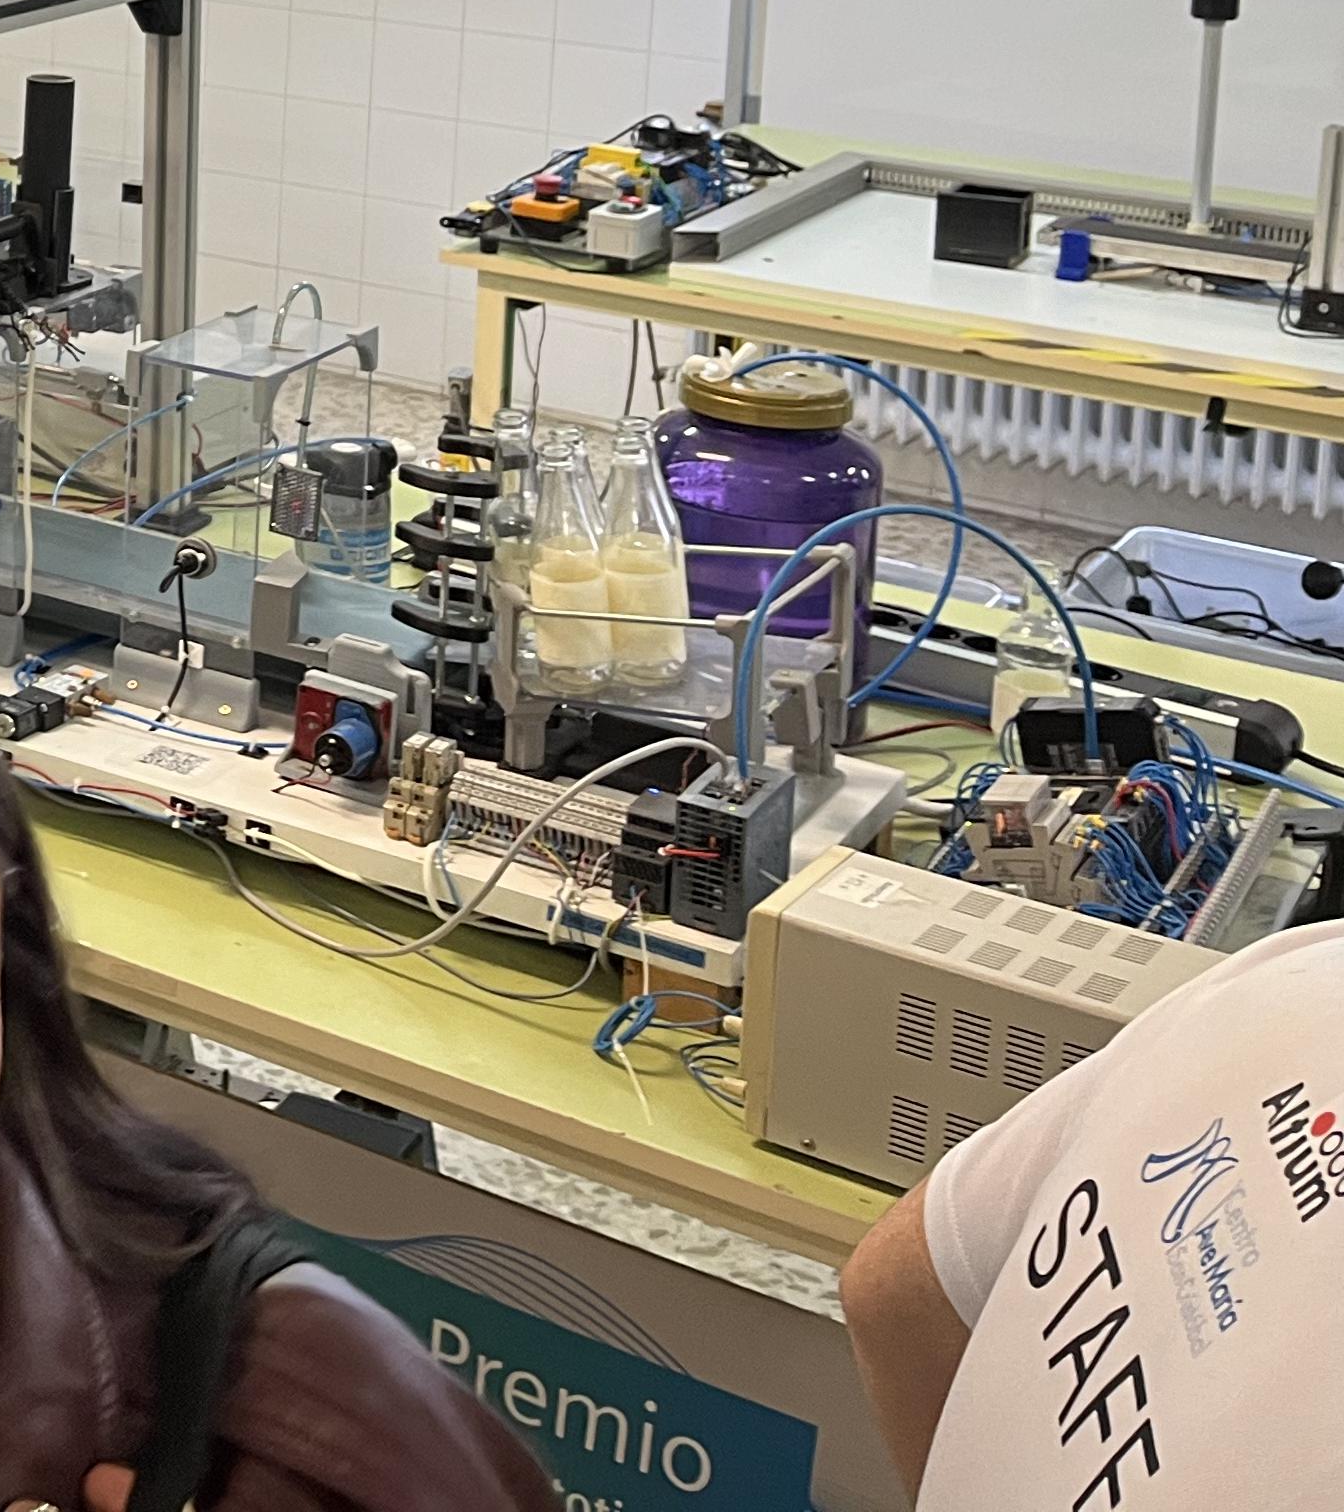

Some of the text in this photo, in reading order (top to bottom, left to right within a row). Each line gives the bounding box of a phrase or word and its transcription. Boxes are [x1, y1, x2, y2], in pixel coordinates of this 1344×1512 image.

[1262, 1081, 1331, 1224] Altium
[429, 1317, 713, 1493] Premio
[1027, 1178, 1161, 1512] STAFF
